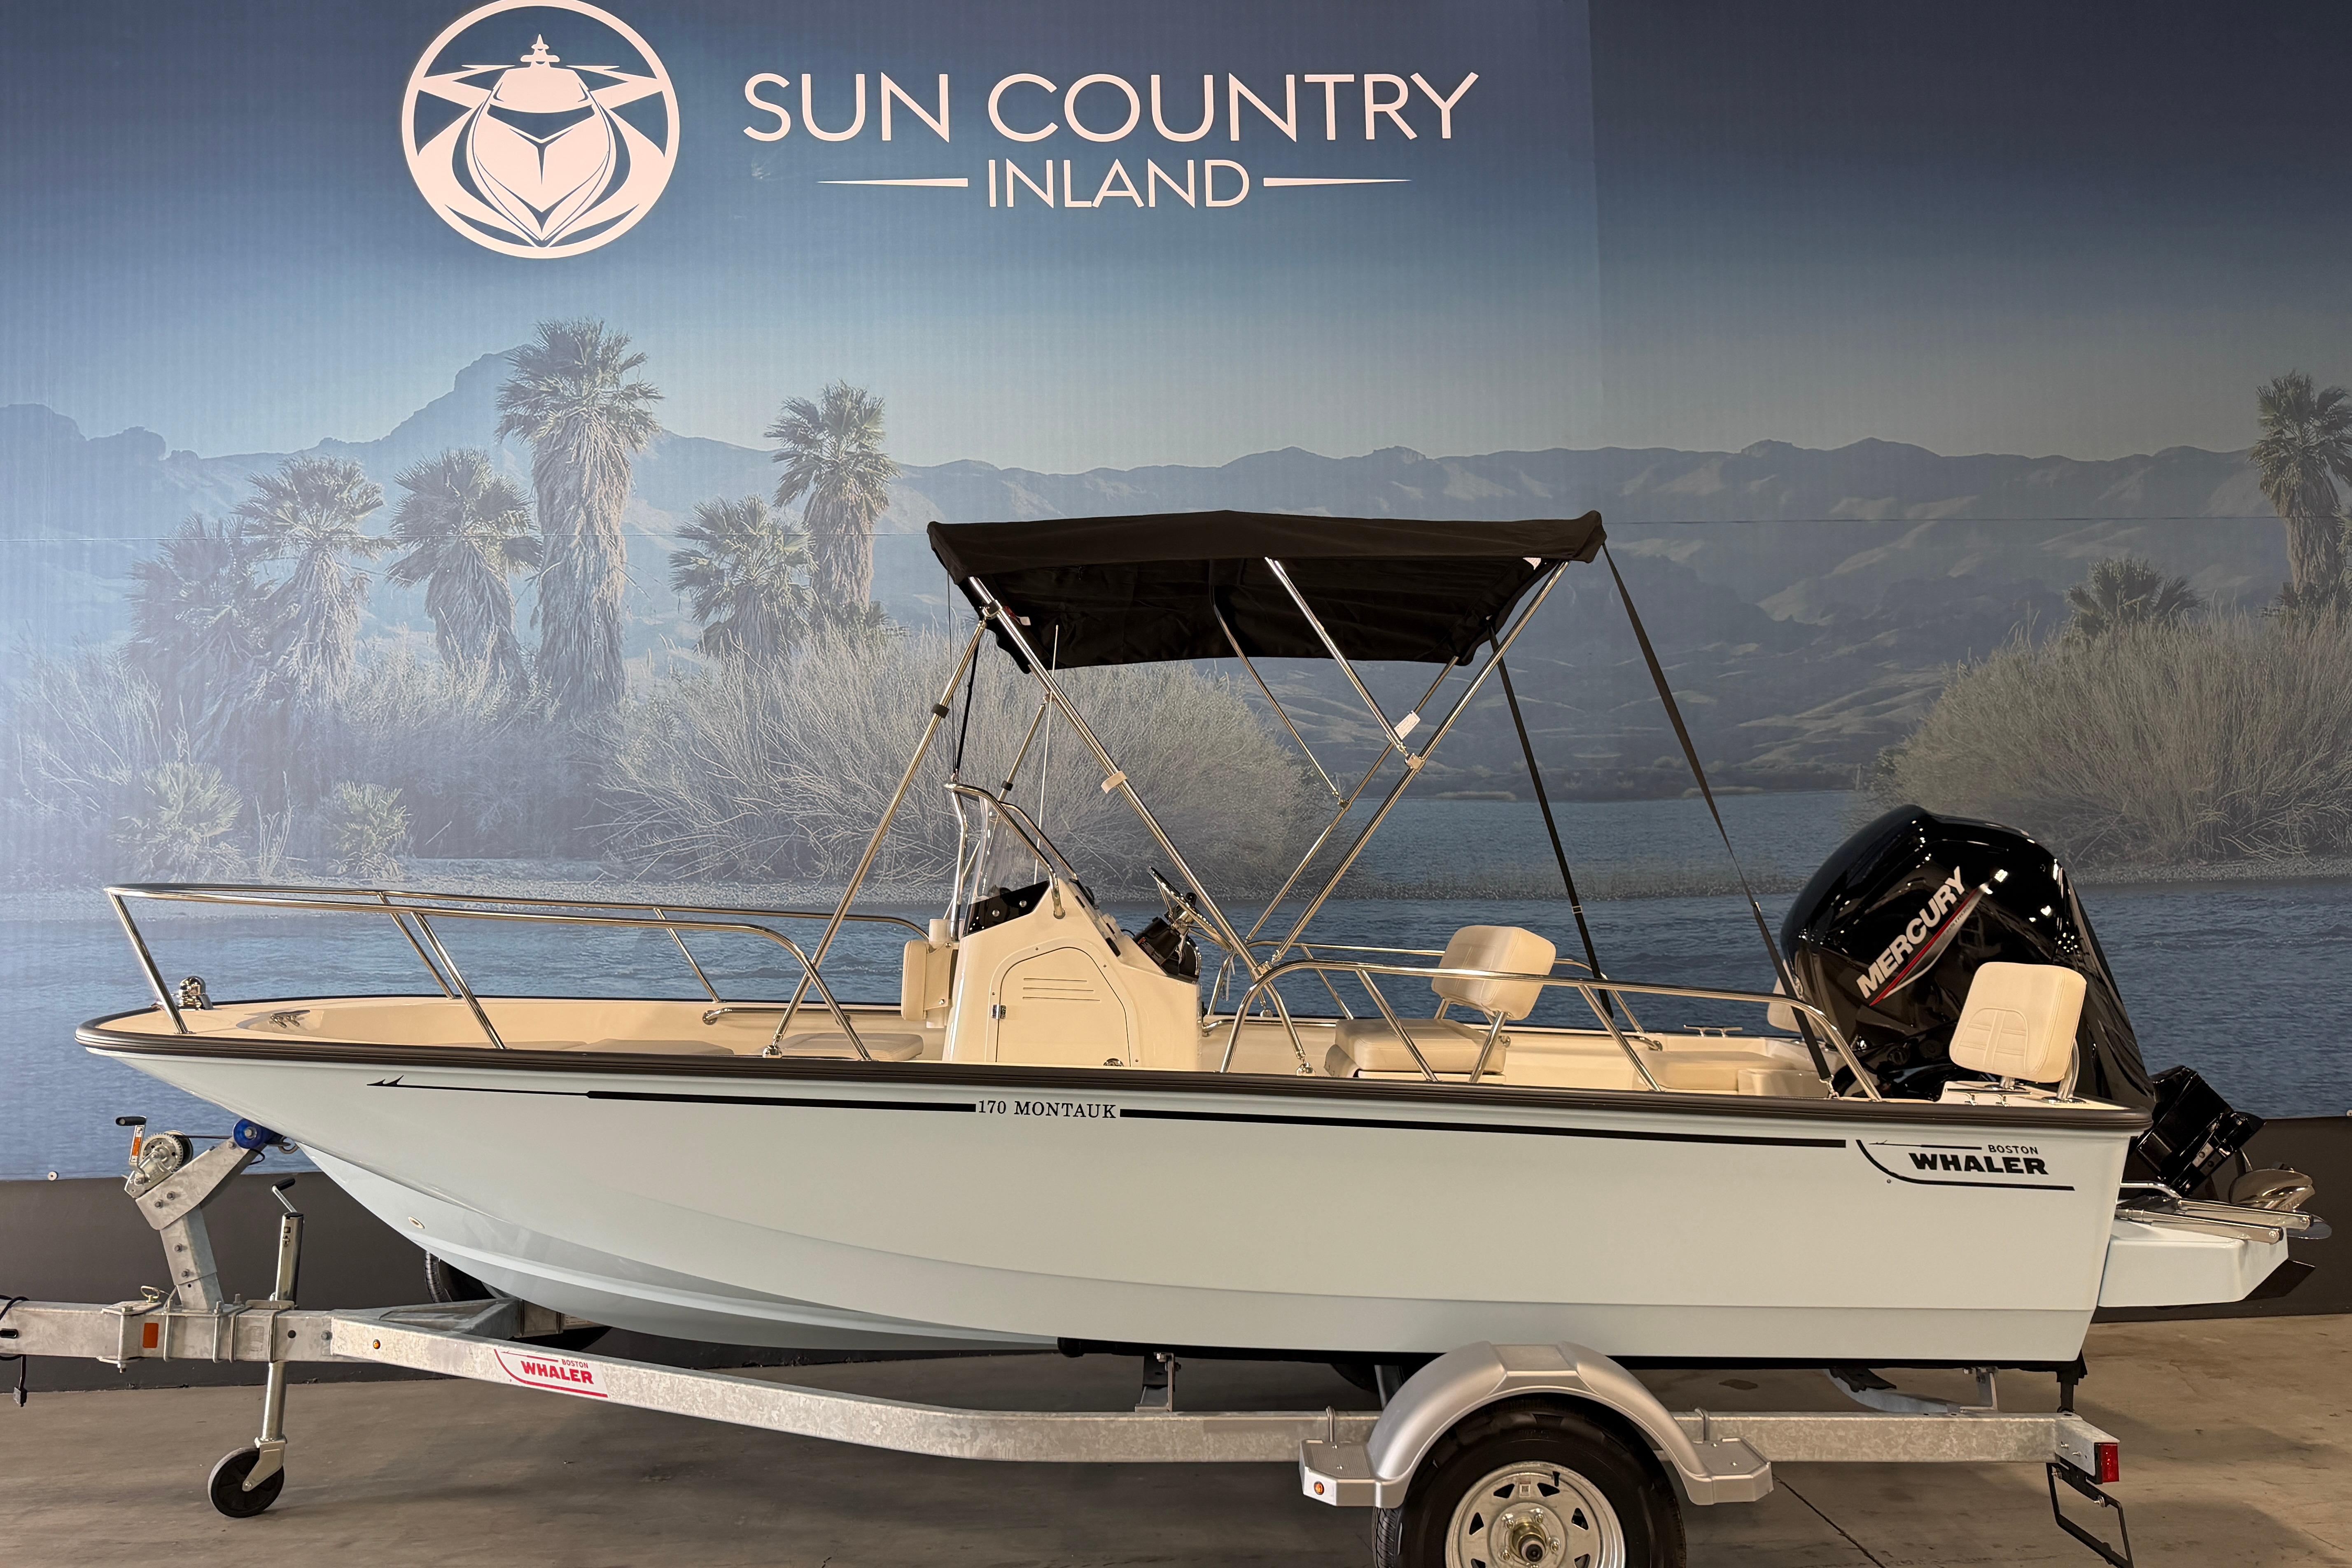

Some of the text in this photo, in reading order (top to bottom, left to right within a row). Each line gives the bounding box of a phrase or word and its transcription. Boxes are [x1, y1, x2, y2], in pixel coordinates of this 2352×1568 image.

[743, 72, 1479, 143] SUN COUNTRY
[988, 158, 1250, 209] INLAND
[1856, 866, 1965, 999] MERCURY
[978, 1100, 1116, 1119] 170 MONTAUK
[1988, 1144, 2038, 1155] BOSTON
[1908, 1153, 2049, 1175] WHALER
[520, 1360, 594, 1385] WHALER
[561, 1358, 588, 1369] BOSTON
